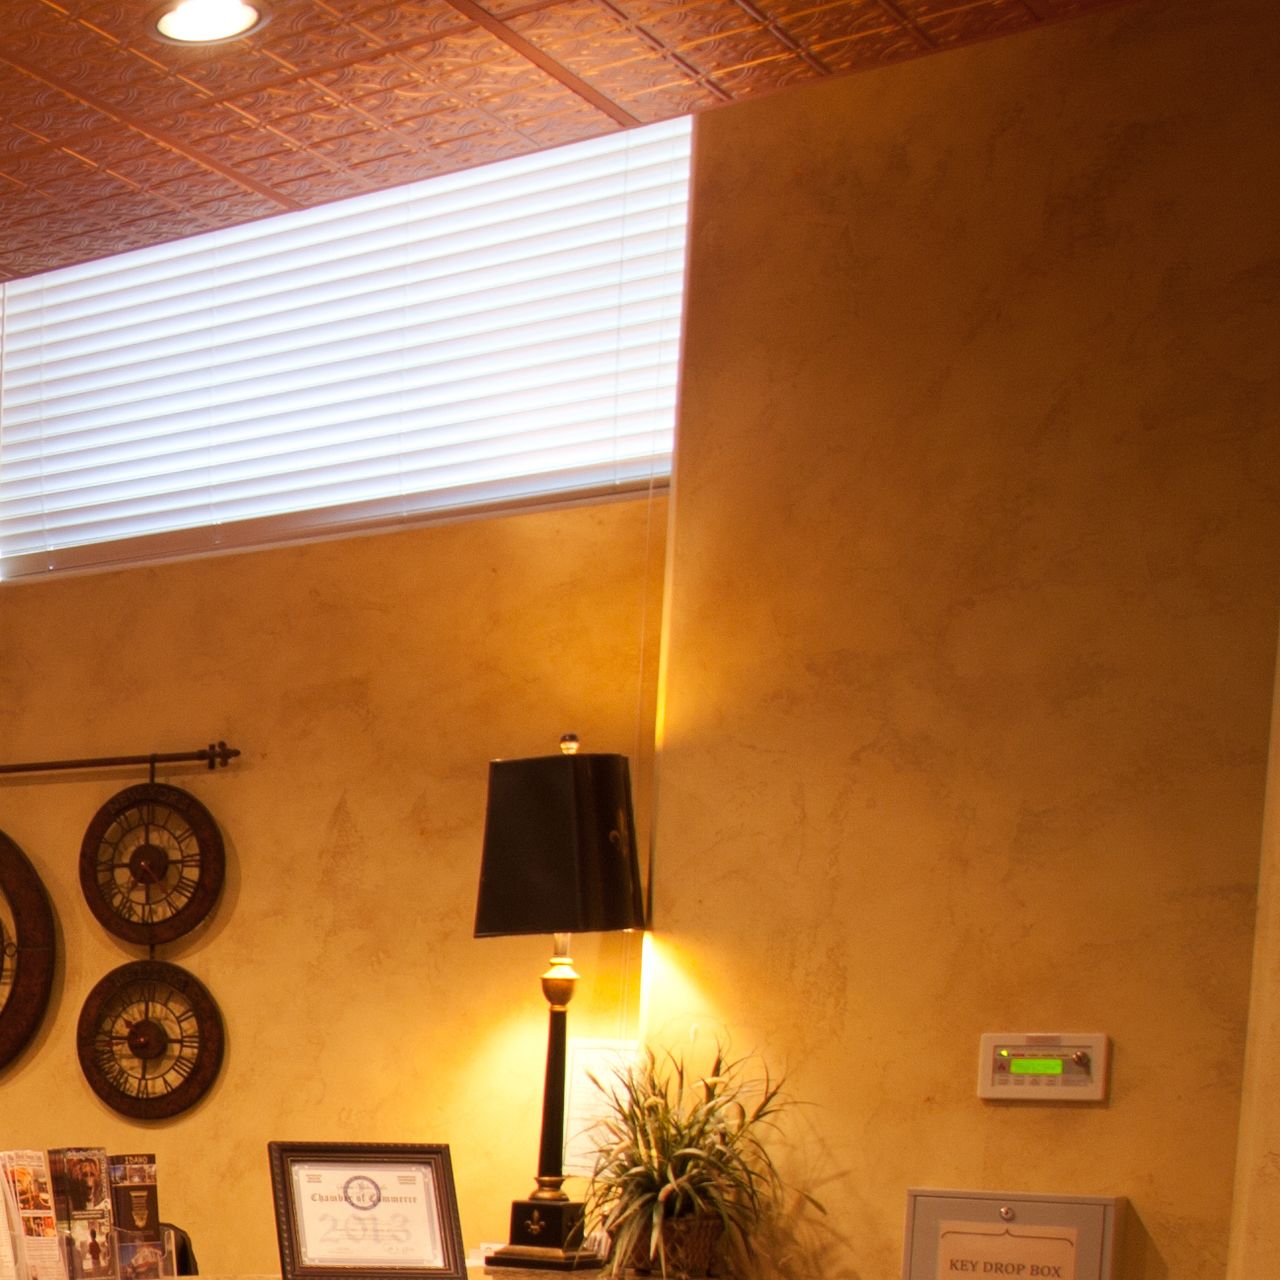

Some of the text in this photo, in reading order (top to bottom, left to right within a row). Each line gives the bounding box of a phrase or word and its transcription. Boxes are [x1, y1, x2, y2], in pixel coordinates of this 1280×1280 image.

[368, 1192, 417, 1203] Cmmerce
[949, 1259, 1062, 1278] KEY DROP BOX
